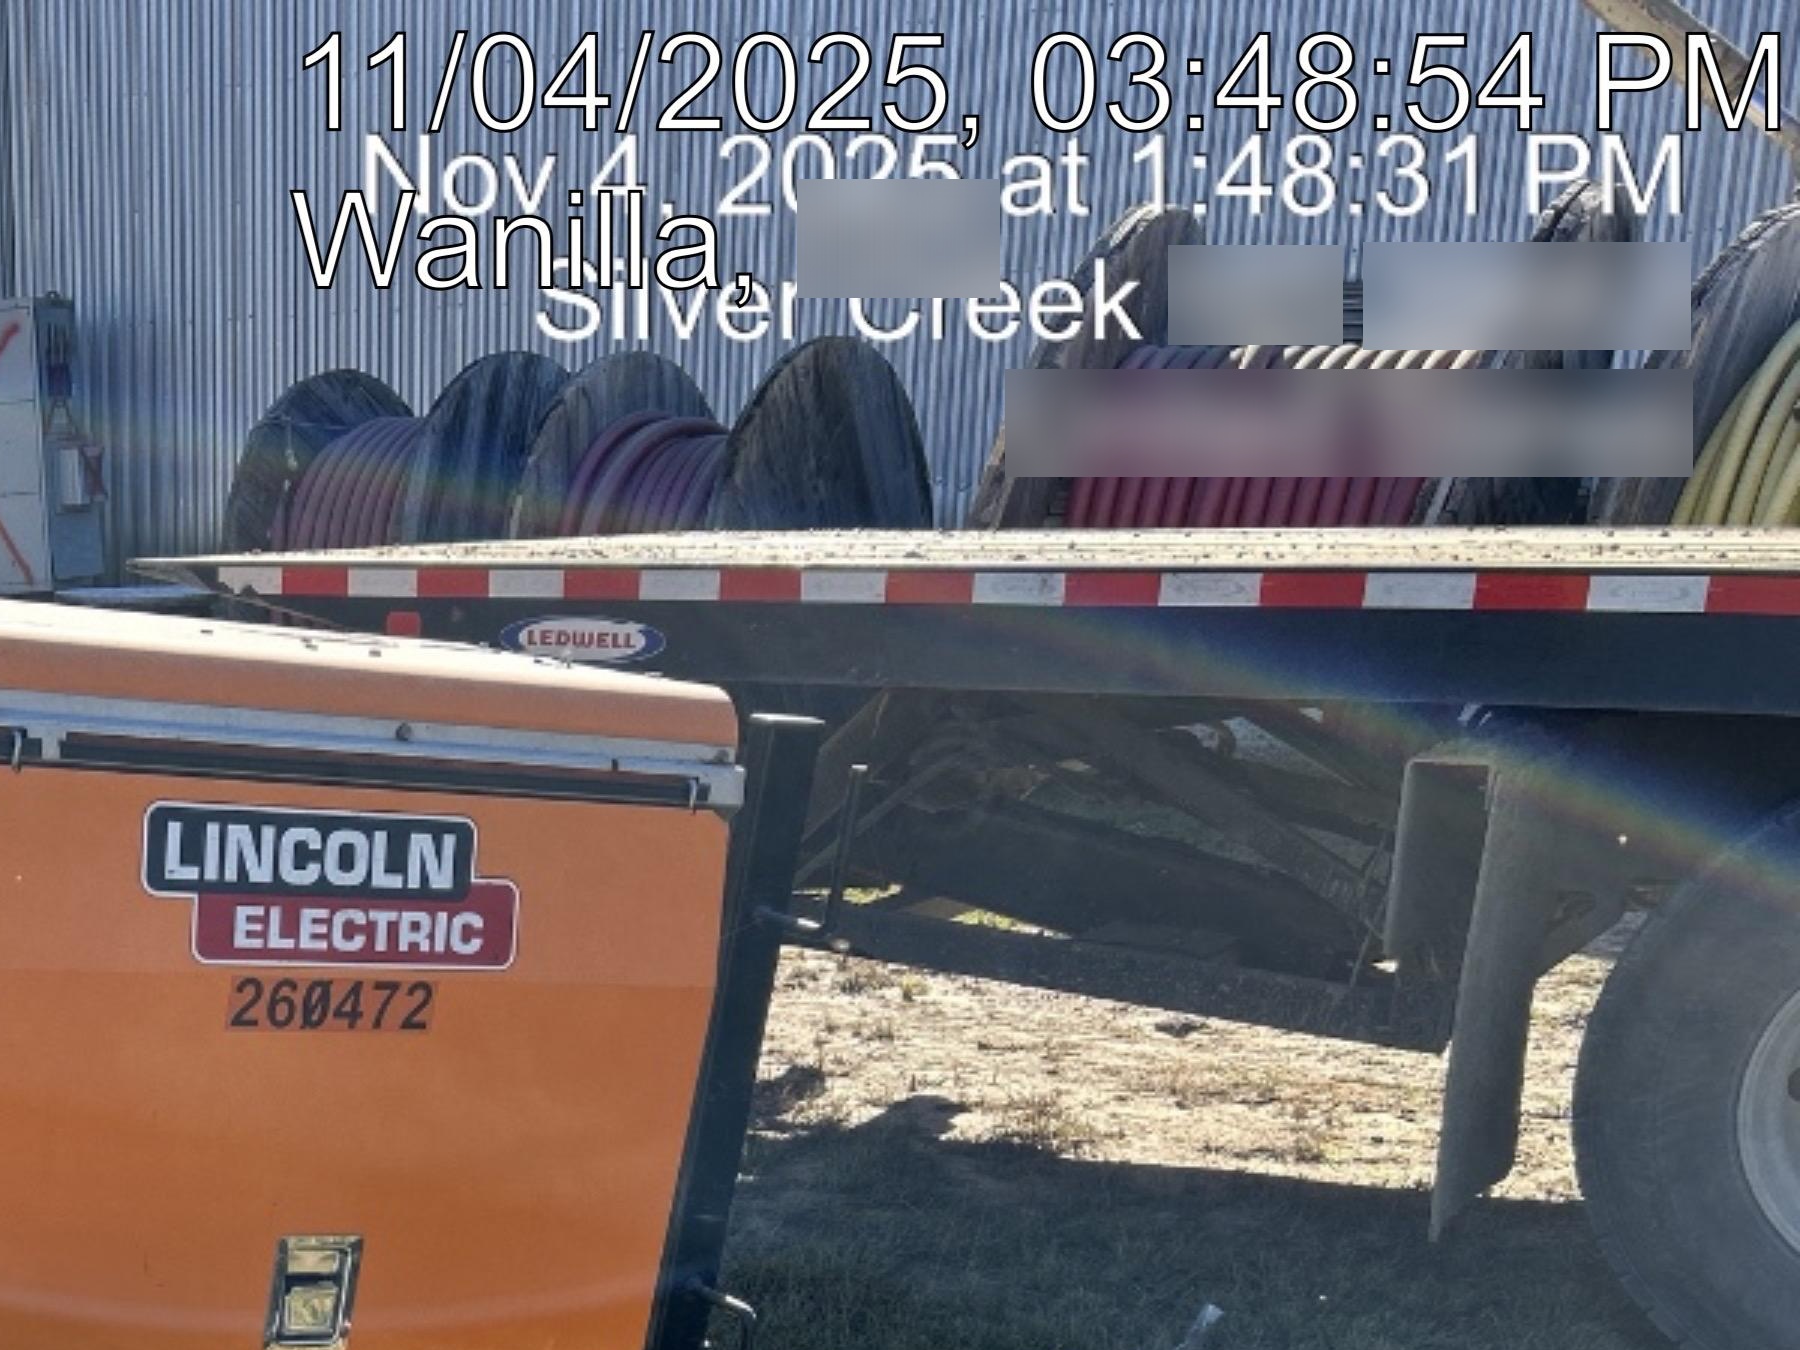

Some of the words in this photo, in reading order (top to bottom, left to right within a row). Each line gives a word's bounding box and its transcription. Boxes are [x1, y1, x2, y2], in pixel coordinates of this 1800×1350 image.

[526, 630, 636, 649] LEDWELL
[164, 821, 458, 890] LINCOLN
[233, 905, 485, 955] ELECTRIC
[229, 977, 434, 1031] 260472
